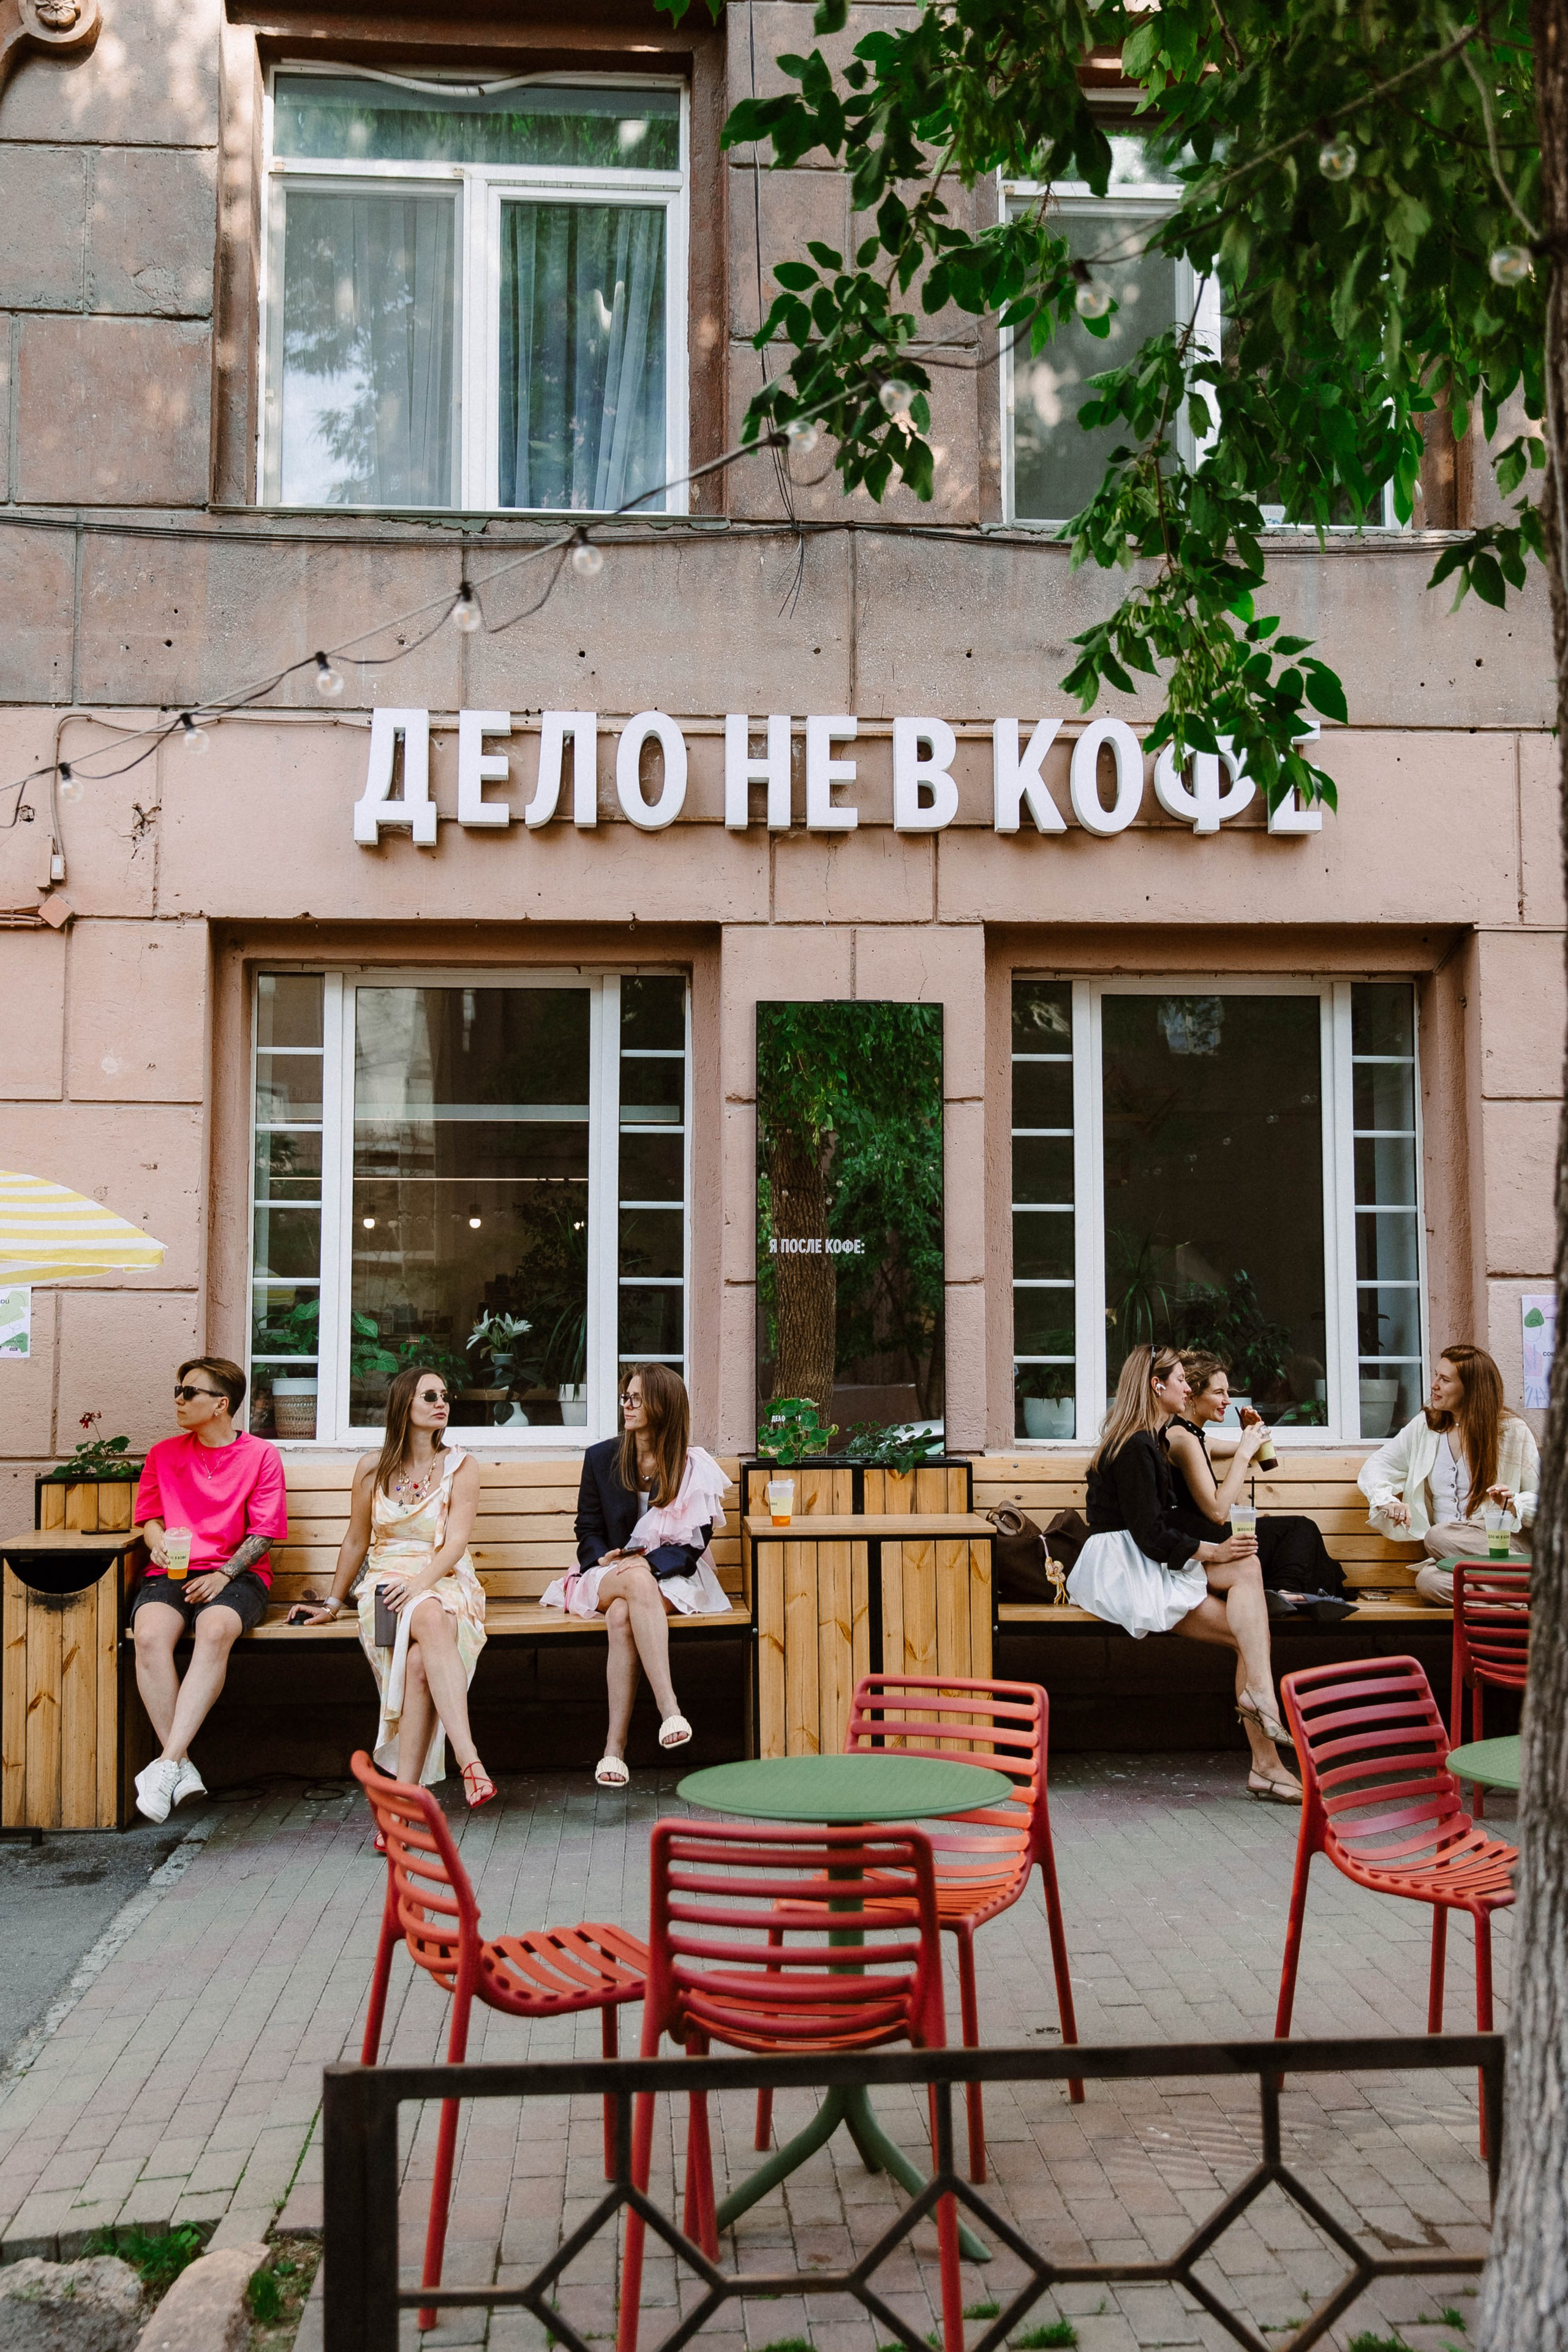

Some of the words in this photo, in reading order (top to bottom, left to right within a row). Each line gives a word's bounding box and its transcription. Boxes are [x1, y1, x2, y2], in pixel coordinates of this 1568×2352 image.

[354, 708, 687, 846] ДЕЛО
[725, 714, 859, 832] НЕ
[893, 717, 959, 833] В
[769, 1238, 777, 1253] Я
[781, 1238, 821, 1253] ПОСЛЕ
[826, 1238, 865, 1254] КОФЕ:
